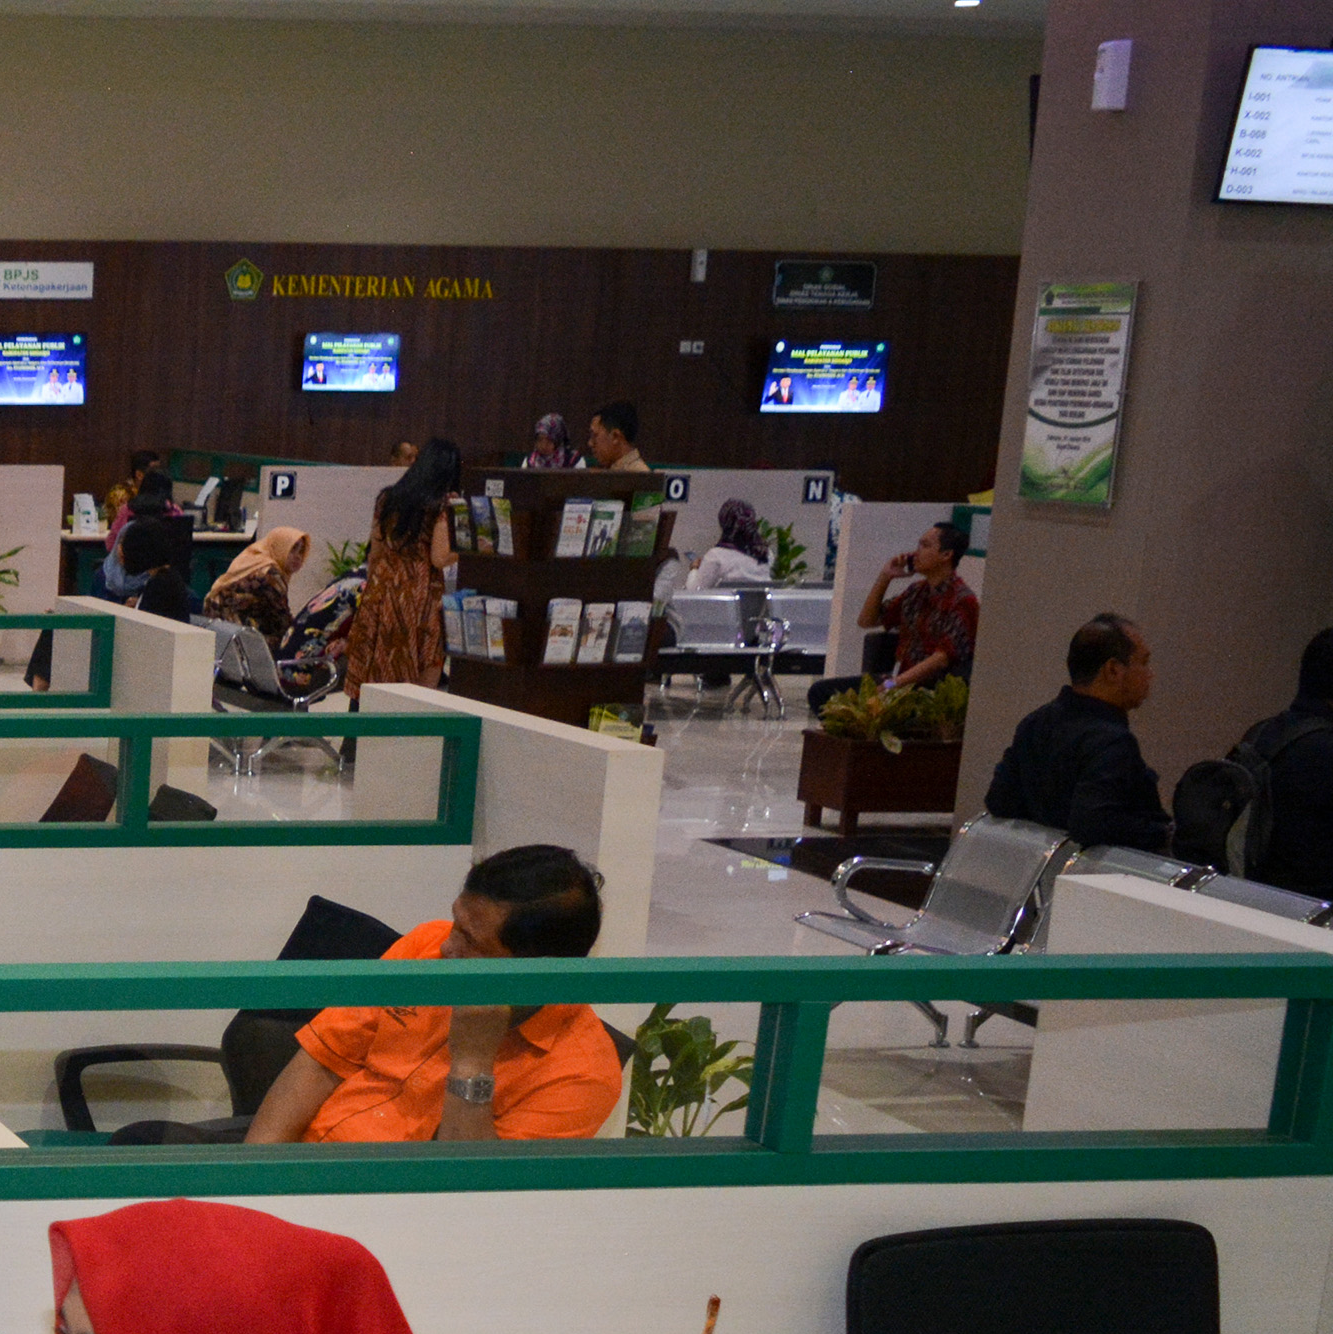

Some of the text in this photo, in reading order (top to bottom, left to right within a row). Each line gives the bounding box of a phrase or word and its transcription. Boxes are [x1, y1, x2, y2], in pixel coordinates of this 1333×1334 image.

[1244, 110, 1271, 120] X-002
[1235, 149, 1262, 158] K-002
[1230, 167, 1258, 176] H-001
[3, 269, 39, 281] BPJS
[3, 283, 88, 293] Ketenagakerjaan
[272, 275, 493, 298] KEMENTERIAN AGAMA
[276, 475, 290, 496] P
[669, 479, 684, 498] O
[808, 480, 823, 499] N
